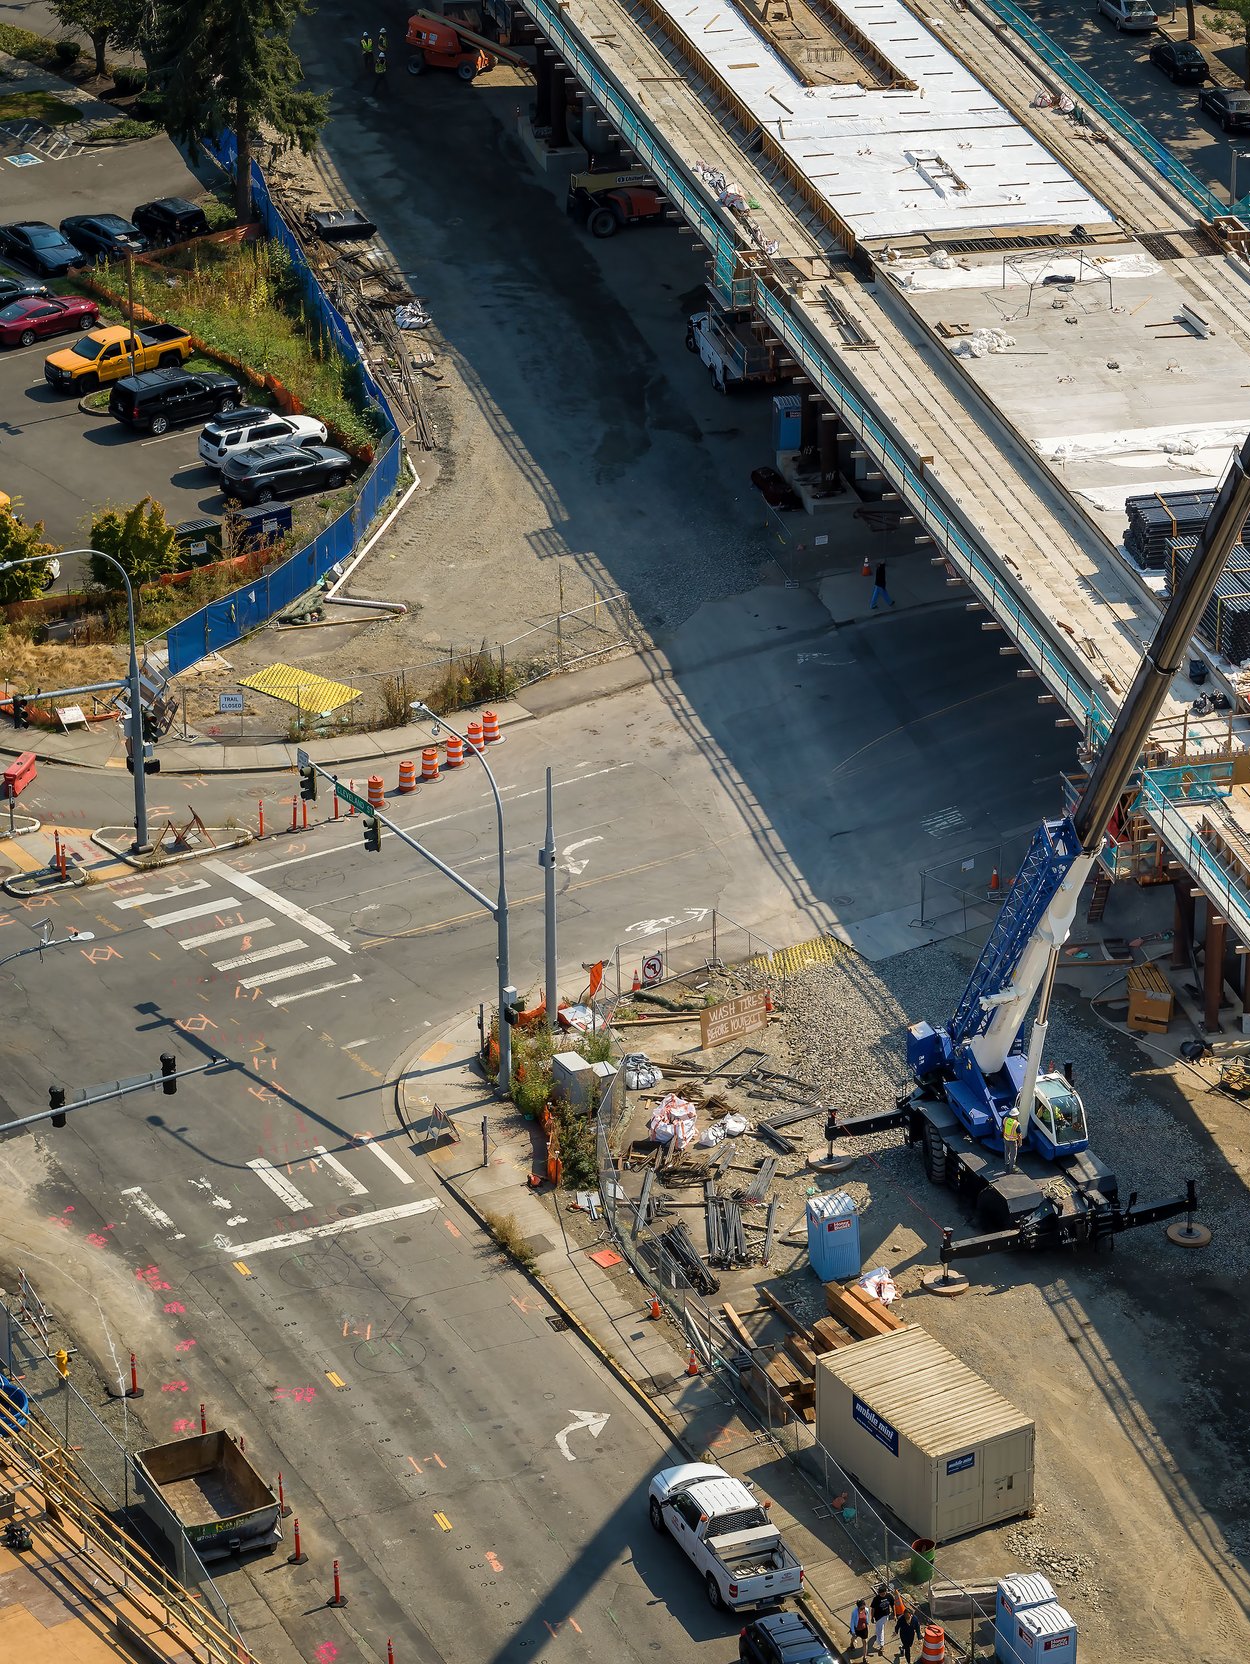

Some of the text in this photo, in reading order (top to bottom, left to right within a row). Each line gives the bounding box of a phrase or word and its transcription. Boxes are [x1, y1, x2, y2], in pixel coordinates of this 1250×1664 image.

[336, 786, 373, 814] CLEVELAND ST
[708, 993, 764, 1022] WASH TIRES
[706, 1022, 730, 1041] BEFORE
[855, 1402, 879, 1427] mobile
[878, 1422, 894, 1440] mini
